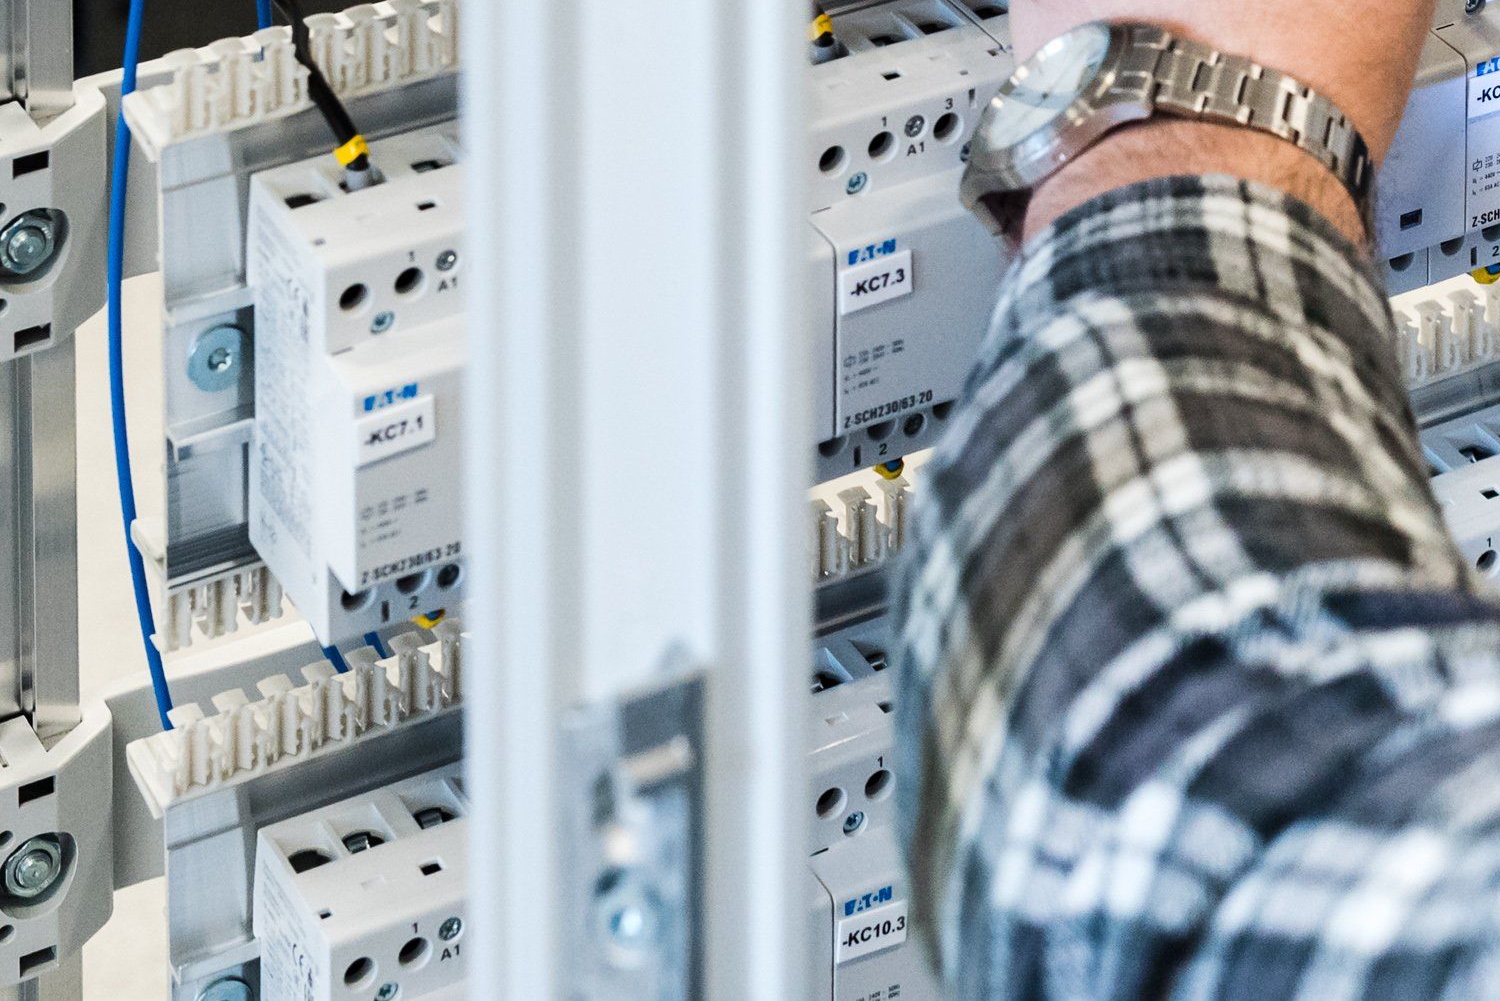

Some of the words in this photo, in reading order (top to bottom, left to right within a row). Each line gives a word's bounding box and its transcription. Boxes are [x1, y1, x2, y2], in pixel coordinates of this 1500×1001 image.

[946, 98, 953, 110] 3
[882, 117, 887, 127] 1
[906, 142, 926, 156] A1
[1492, 246, 1500, 256] 2
[850, 268, 906, 297] -KC7.3
[364, 416, 424, 447] -KC7.1
[879, 444, 887, 456] 2
[1486, 538, 1492, 548] 1
[410, 596, 418, 609] 2
[878, 756, 883, 768] 1
[412, 922, 418, 934] 1
[842, 916, 906, 948] -KC10.3
[441, 944, 460, 962] A1
